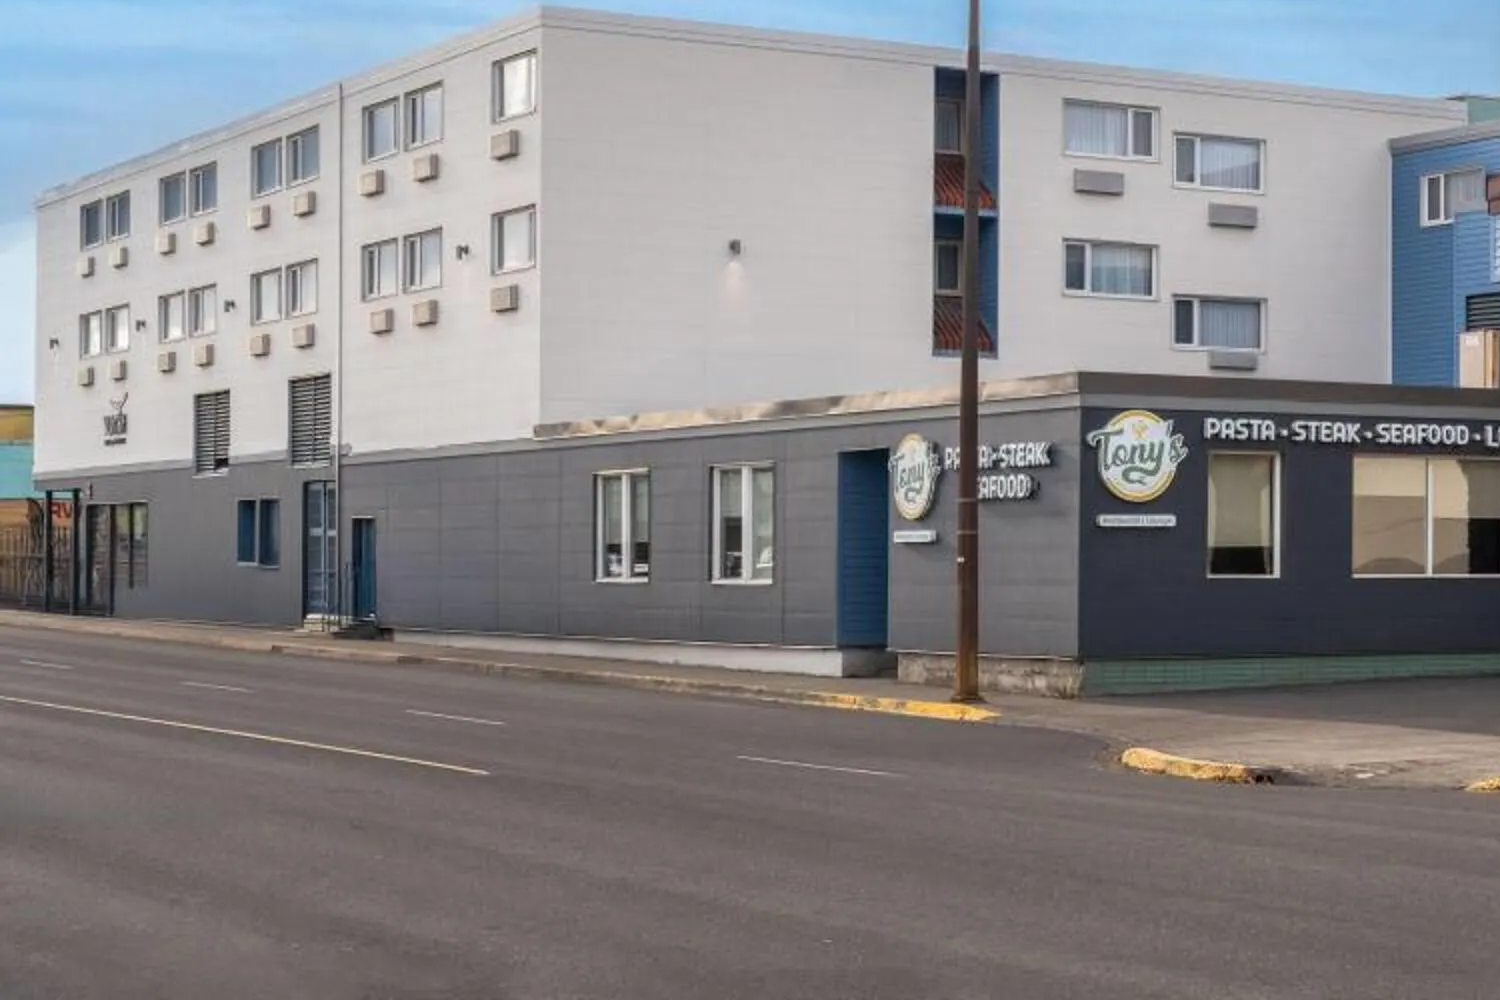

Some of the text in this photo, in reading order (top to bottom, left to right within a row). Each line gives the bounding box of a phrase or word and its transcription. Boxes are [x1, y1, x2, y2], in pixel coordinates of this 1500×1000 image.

[1204, 417, 1275, 441] PASTA
[1291, 420, 1361, 444] STEAK
[1375, 423, 1469, 446] SEAFOOD
[999, 441, 1047, 469] STEAK
[1087, 419, 1189, 487] Tony's
